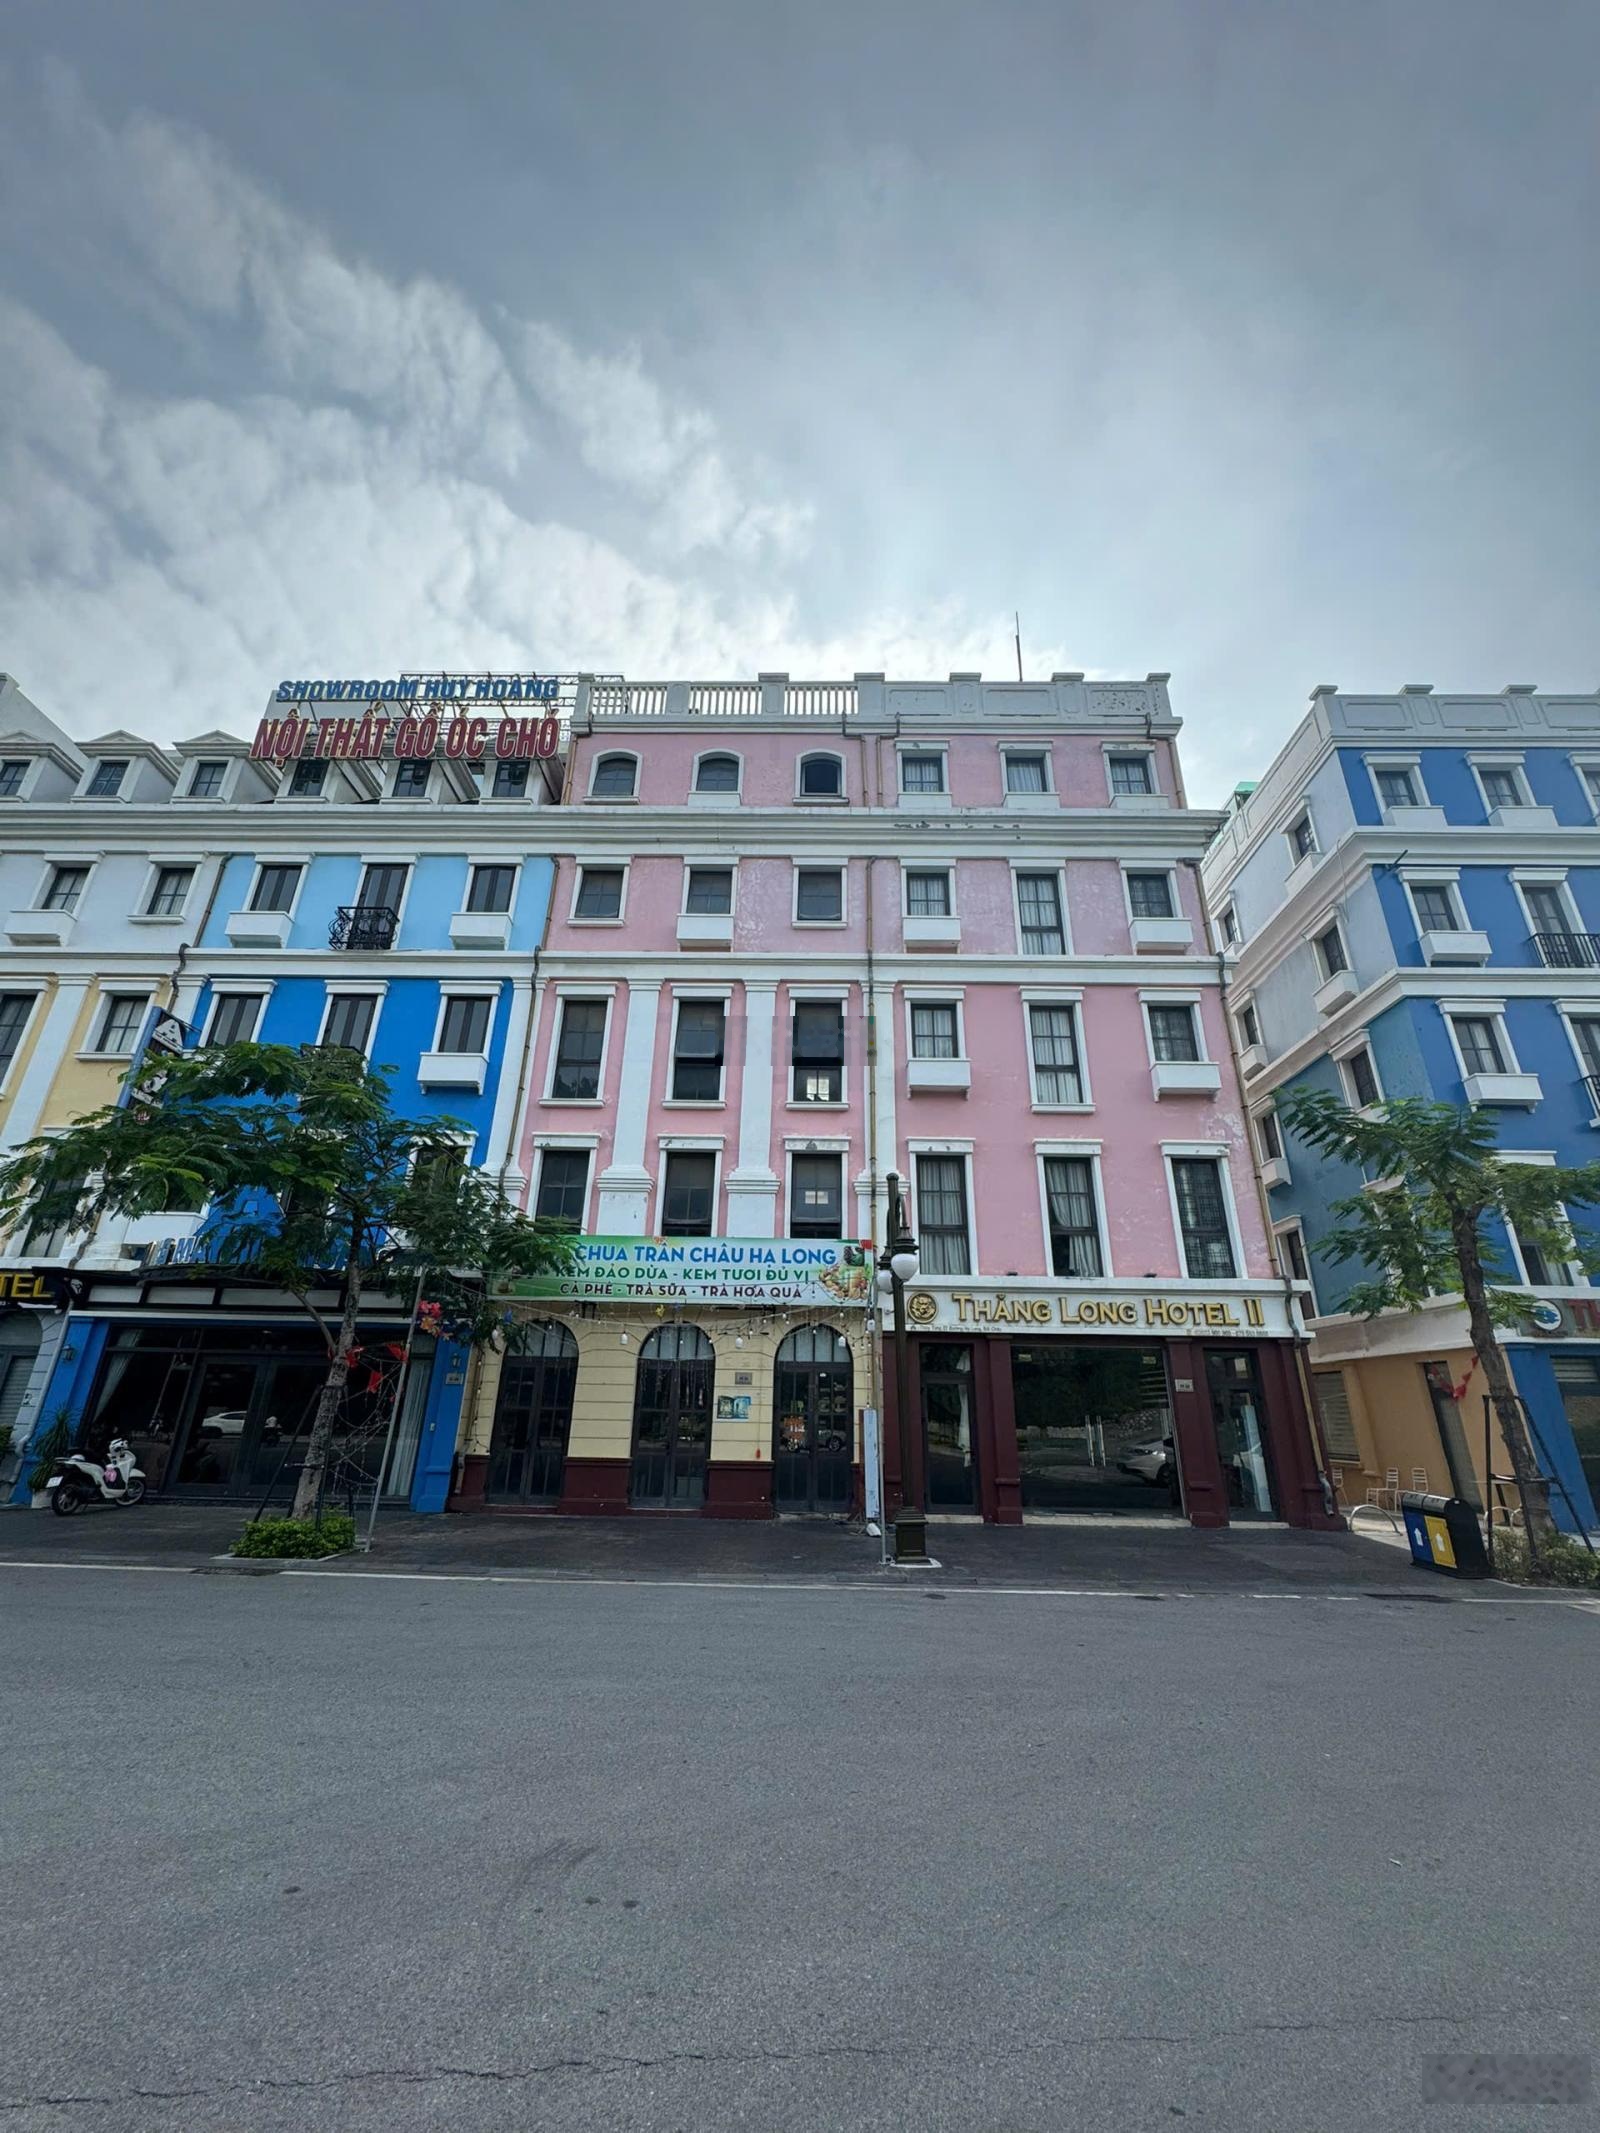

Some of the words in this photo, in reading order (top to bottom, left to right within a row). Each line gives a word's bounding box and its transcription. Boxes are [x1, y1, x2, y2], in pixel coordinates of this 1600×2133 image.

[277, 680, 420, 700] SHOWROOM
[423, 679, 474, 700] HUY
[250, 709, 310, 767] NỘI
[314, 701, 391, 758] THẤT
[393, 701, 440, 758] GỖ
[495, 708, 559, 758] CHÓ
[575, 1244, 627, 1260] CHUA
[634, 1242, 684, 1261] TRÂN
[690, 1243, 744, 1264] CHÂU
[747, 1248, 776, 1268] HẠ
[782, 1249, 836, 1265] LONG
[595, 1263, 630, 1278] ĐẢO
[635, 1264, 668, 1279] DỪA
[683, 1269, 716, 1280] KEM
[722, 1269, 761, 1281] TƯƠI
[766, 1266, 788, 1281] ĐỦ
[560, 1281, 579, 1293] CÀ
[584, 1281, 612, 1294] PHÊ
[627, 1282, 653, 1296] TRÀ
[659, 1283, 687, 1296] SỮA
[701, 1283, 728, 1297] TRÀ
[952, 1292, 1052, 1323] THĂNG
[1059, 1297, 1137, 1324] LONG
[1144, 1299, 1240, 1326] HOTEL
[1243, 1298, 1265, 1327] II
